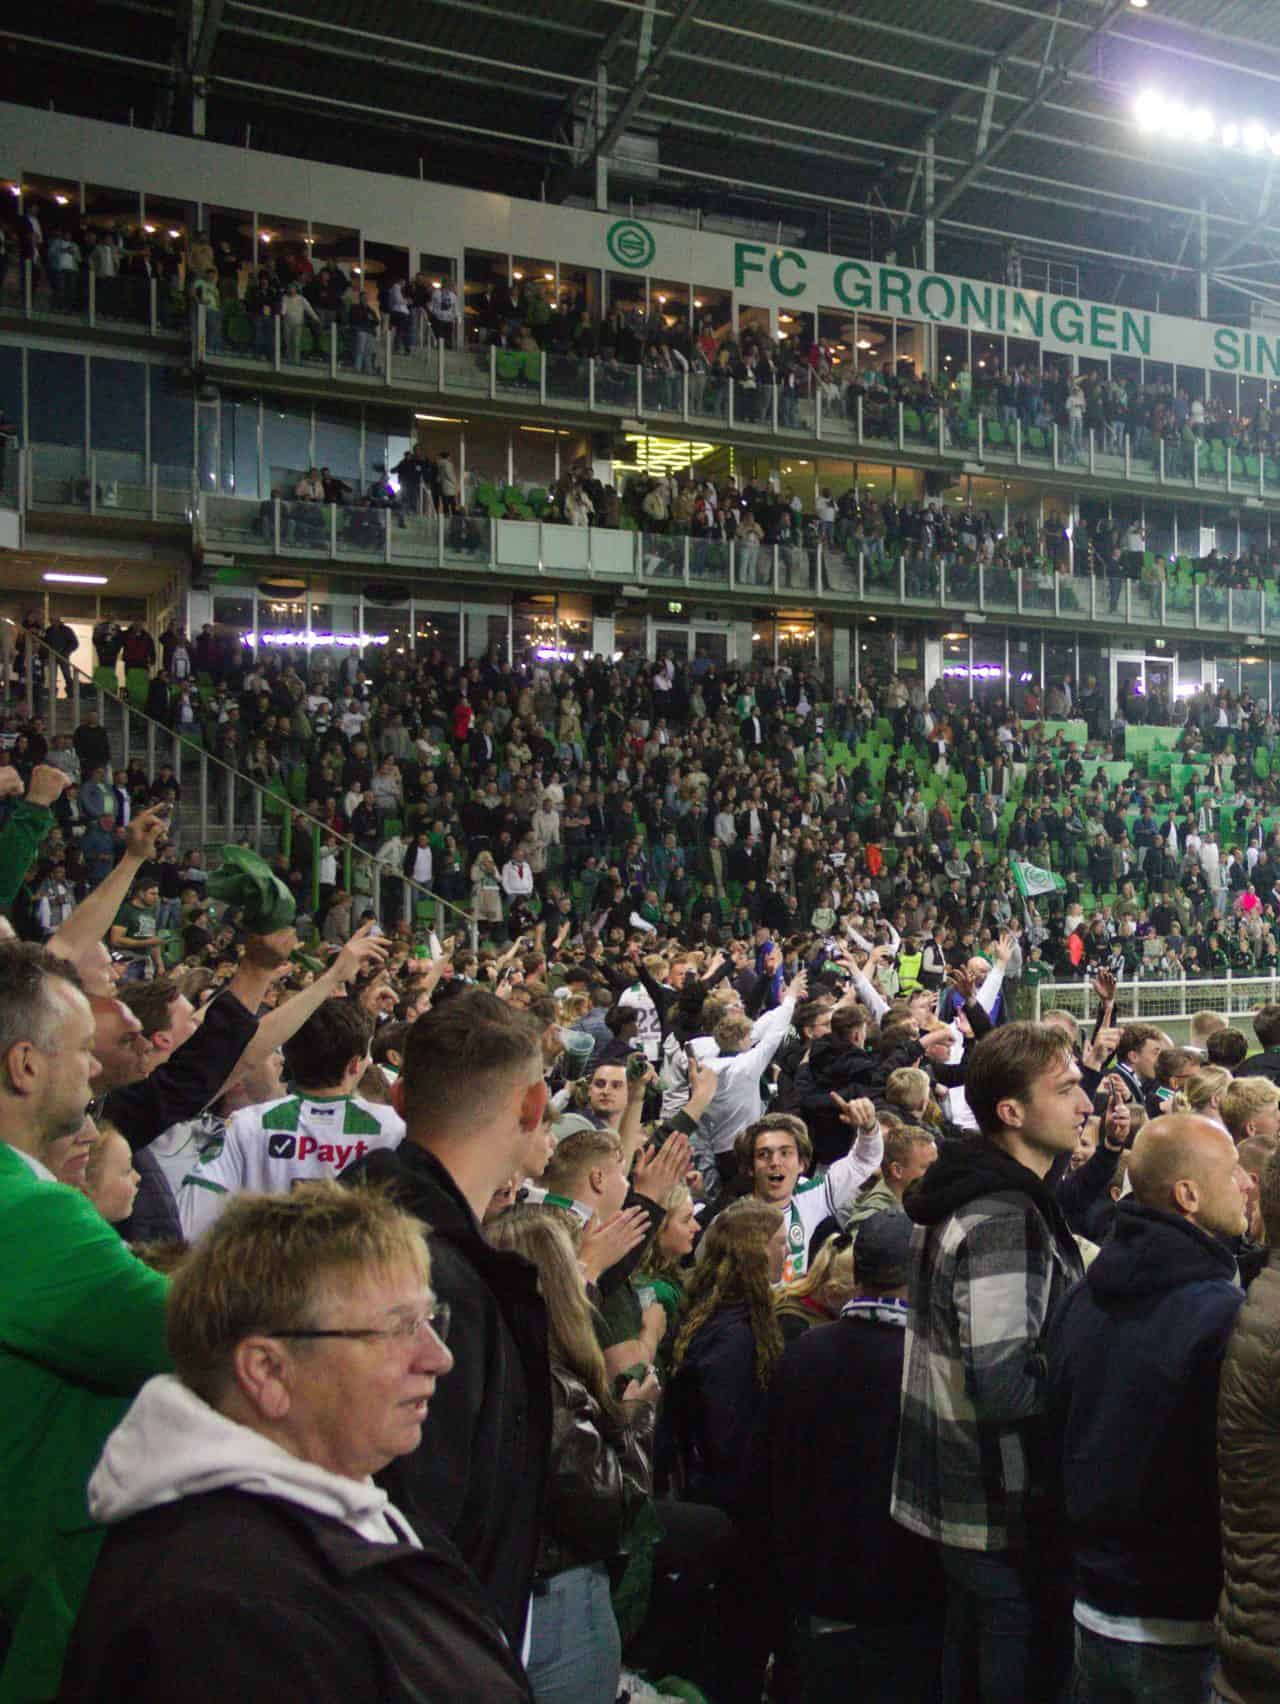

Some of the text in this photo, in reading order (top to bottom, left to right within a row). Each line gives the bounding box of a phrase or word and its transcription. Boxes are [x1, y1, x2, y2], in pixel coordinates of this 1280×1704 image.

[733, 242, 808, 297] FC
[833, 261, 1151, 355] GRONINGEN
[298, 1135, 369, 1170] Payt
